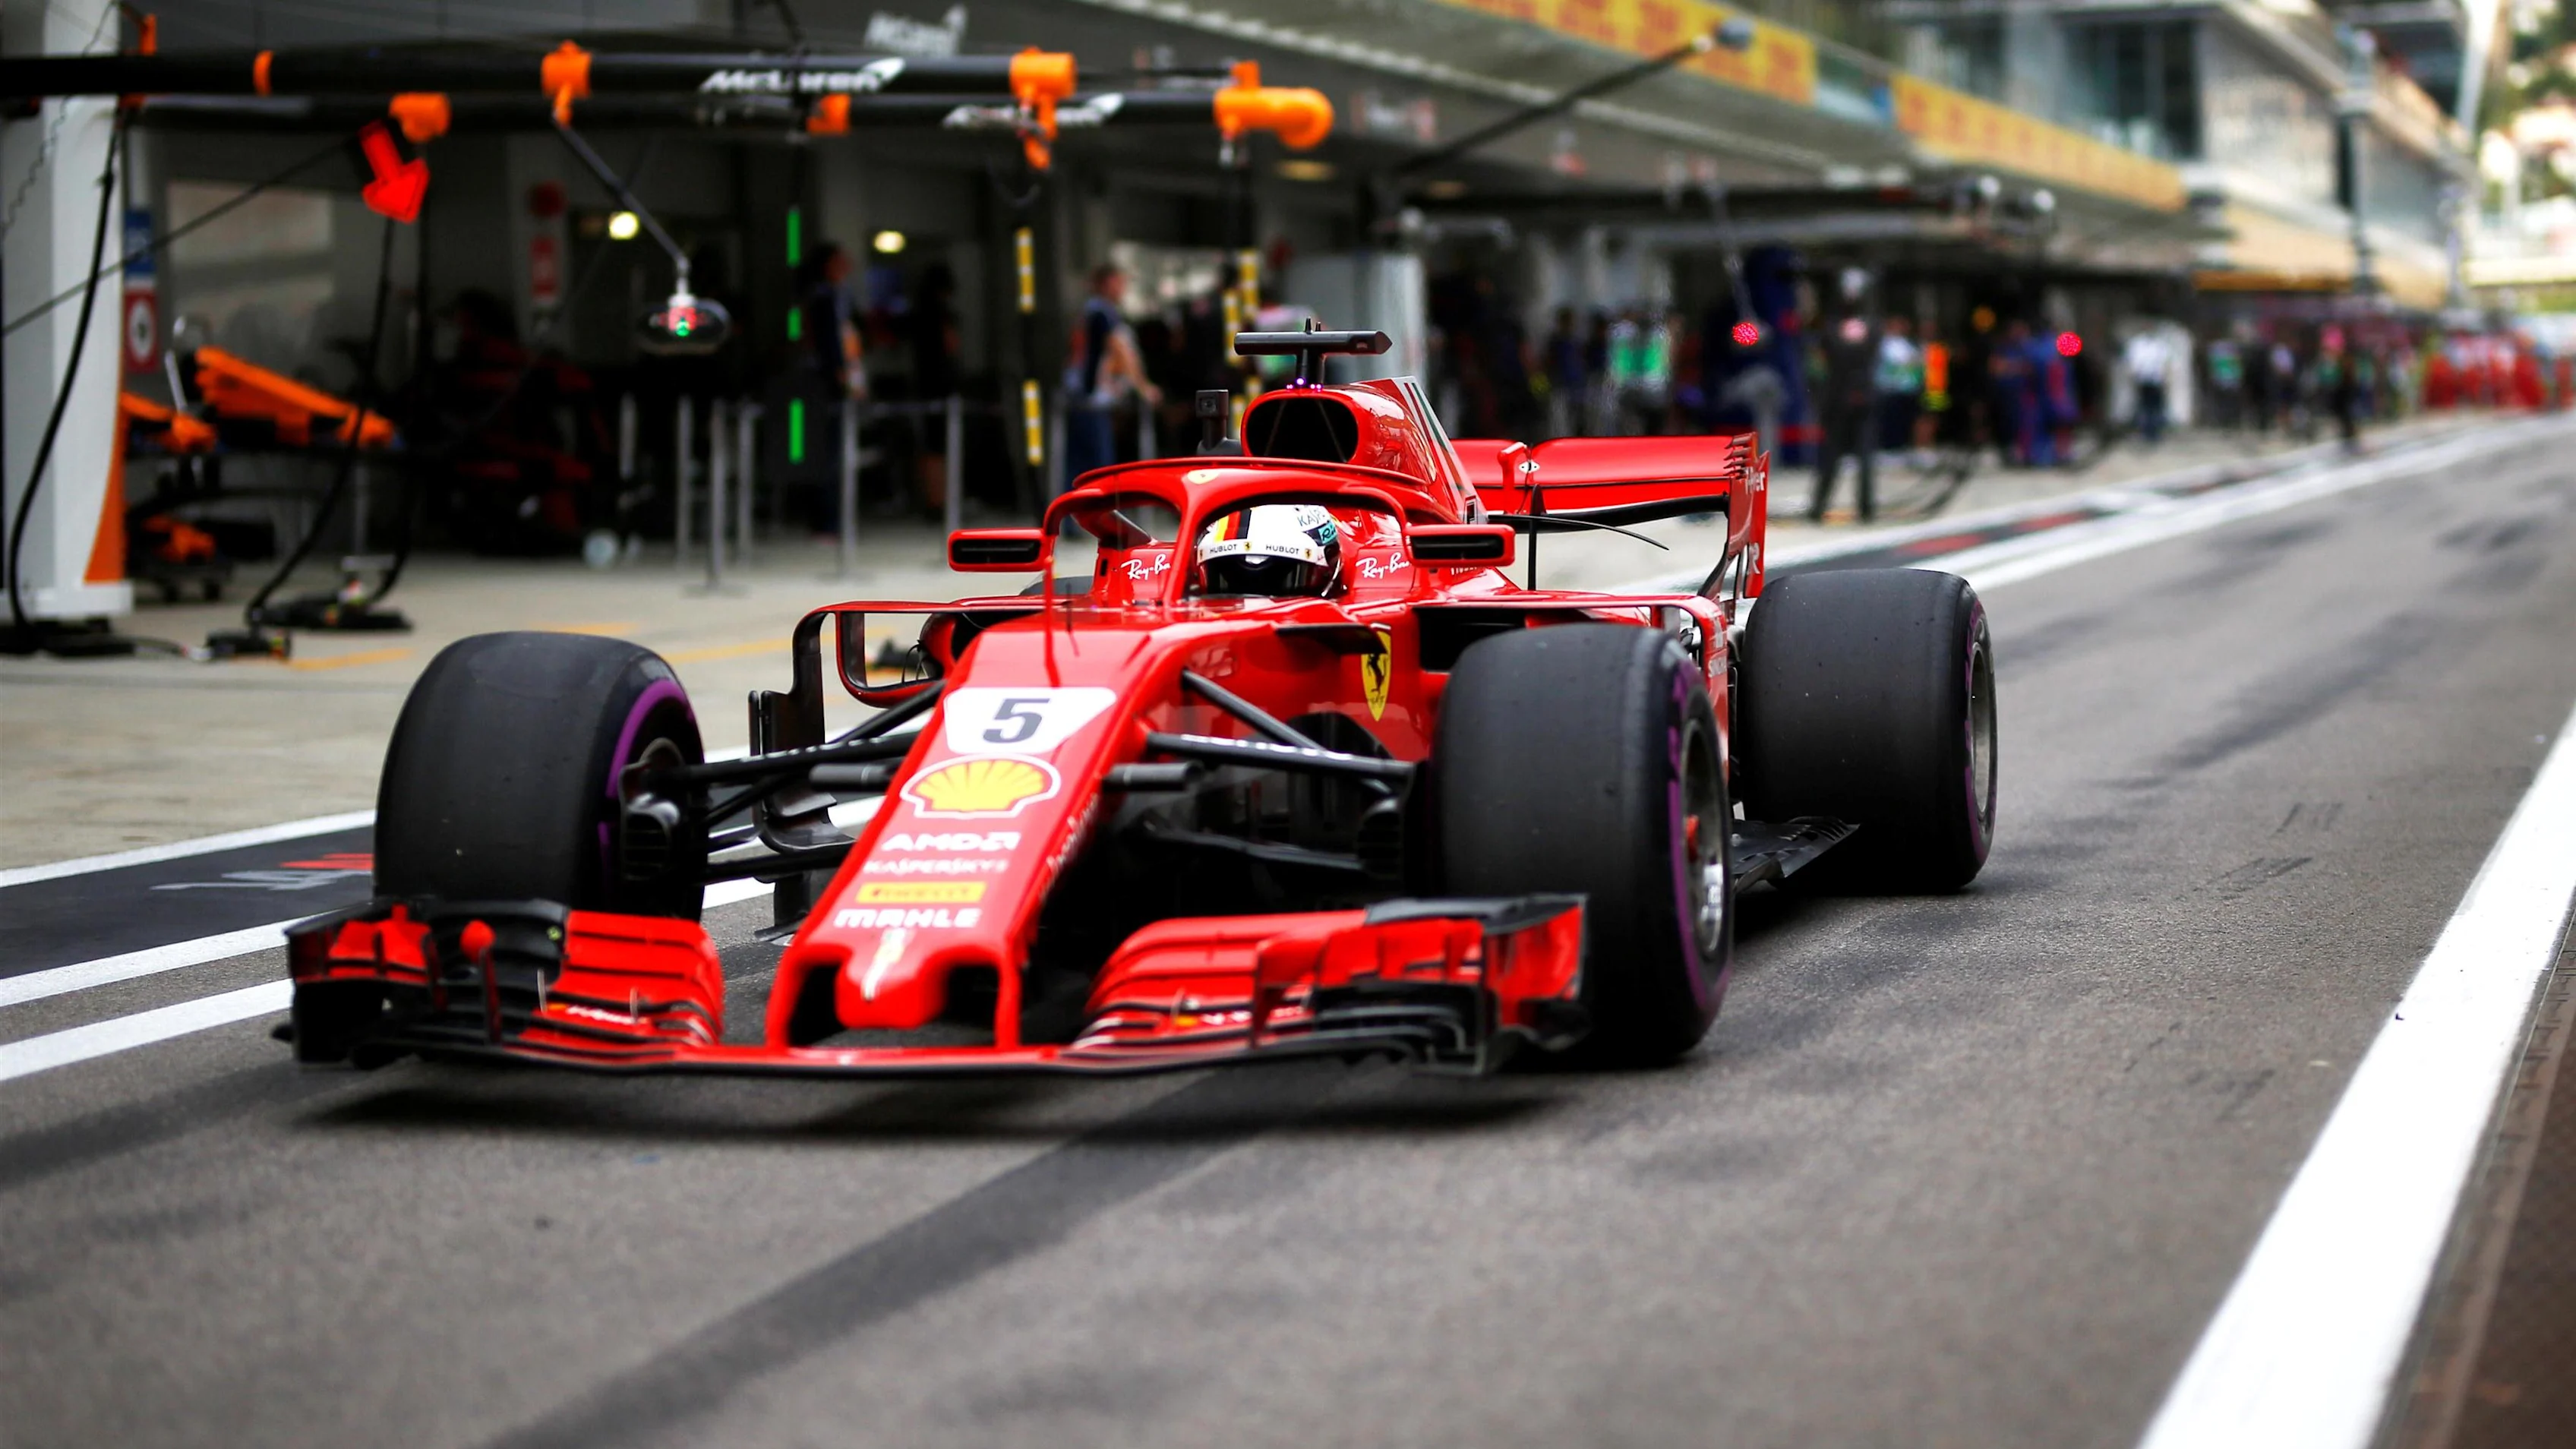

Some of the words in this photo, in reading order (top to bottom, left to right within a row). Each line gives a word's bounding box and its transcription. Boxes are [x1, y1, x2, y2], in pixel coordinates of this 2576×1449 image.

[1210, 544, 1238, 554] HUBLOT
[1265, 545, 1300, 554] HUBLOT
[1120, 553, 1171, 580] Ray-Ba
[983, 698, 1050, 743] 5
[881, 833, 984, 851] AMD
[833, 908, 983, 928] MAHLE
